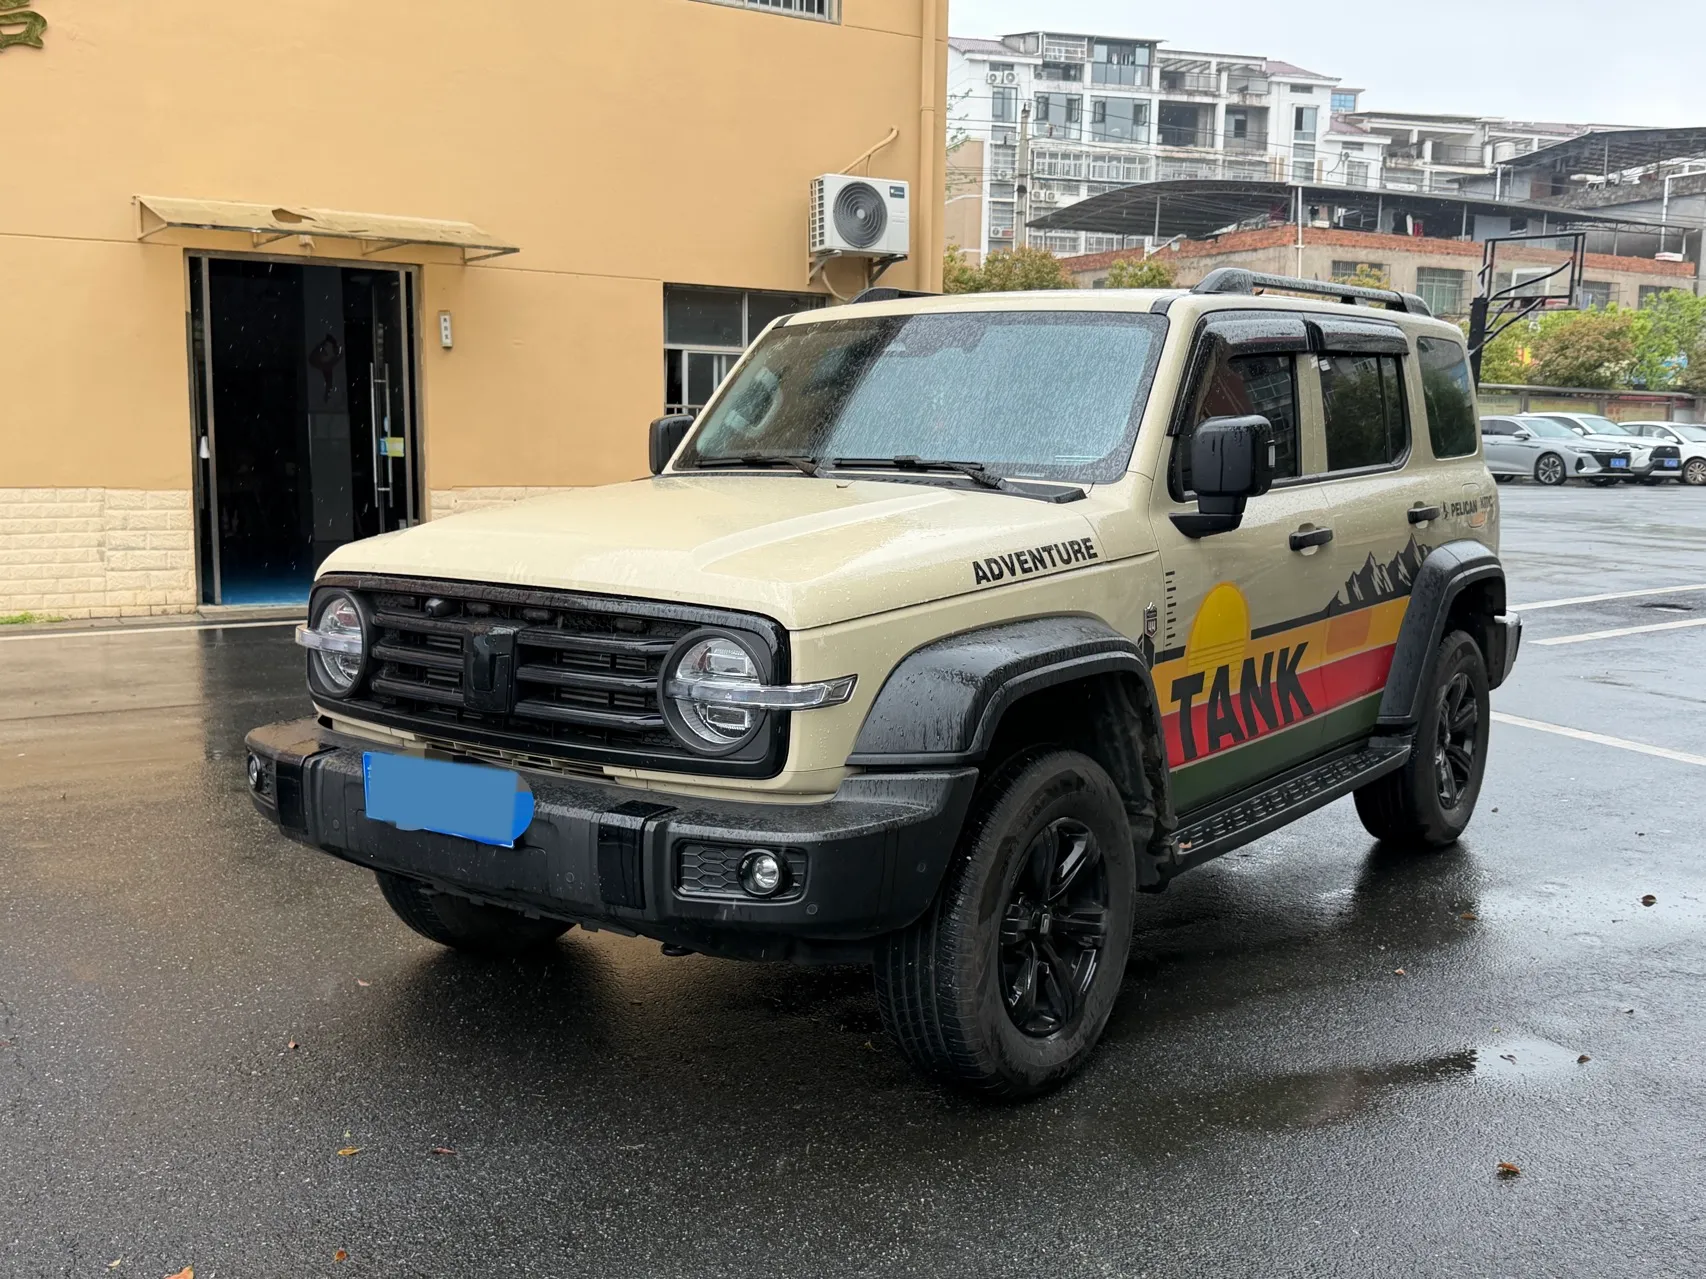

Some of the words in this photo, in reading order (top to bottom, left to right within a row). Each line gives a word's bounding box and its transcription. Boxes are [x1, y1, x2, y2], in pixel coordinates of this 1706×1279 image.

[1451, 500, 1478, 517] PELICAN
[972, 537, 1098, 585] ADVENTURE
[1171, 641, 1314, 760] TANK
